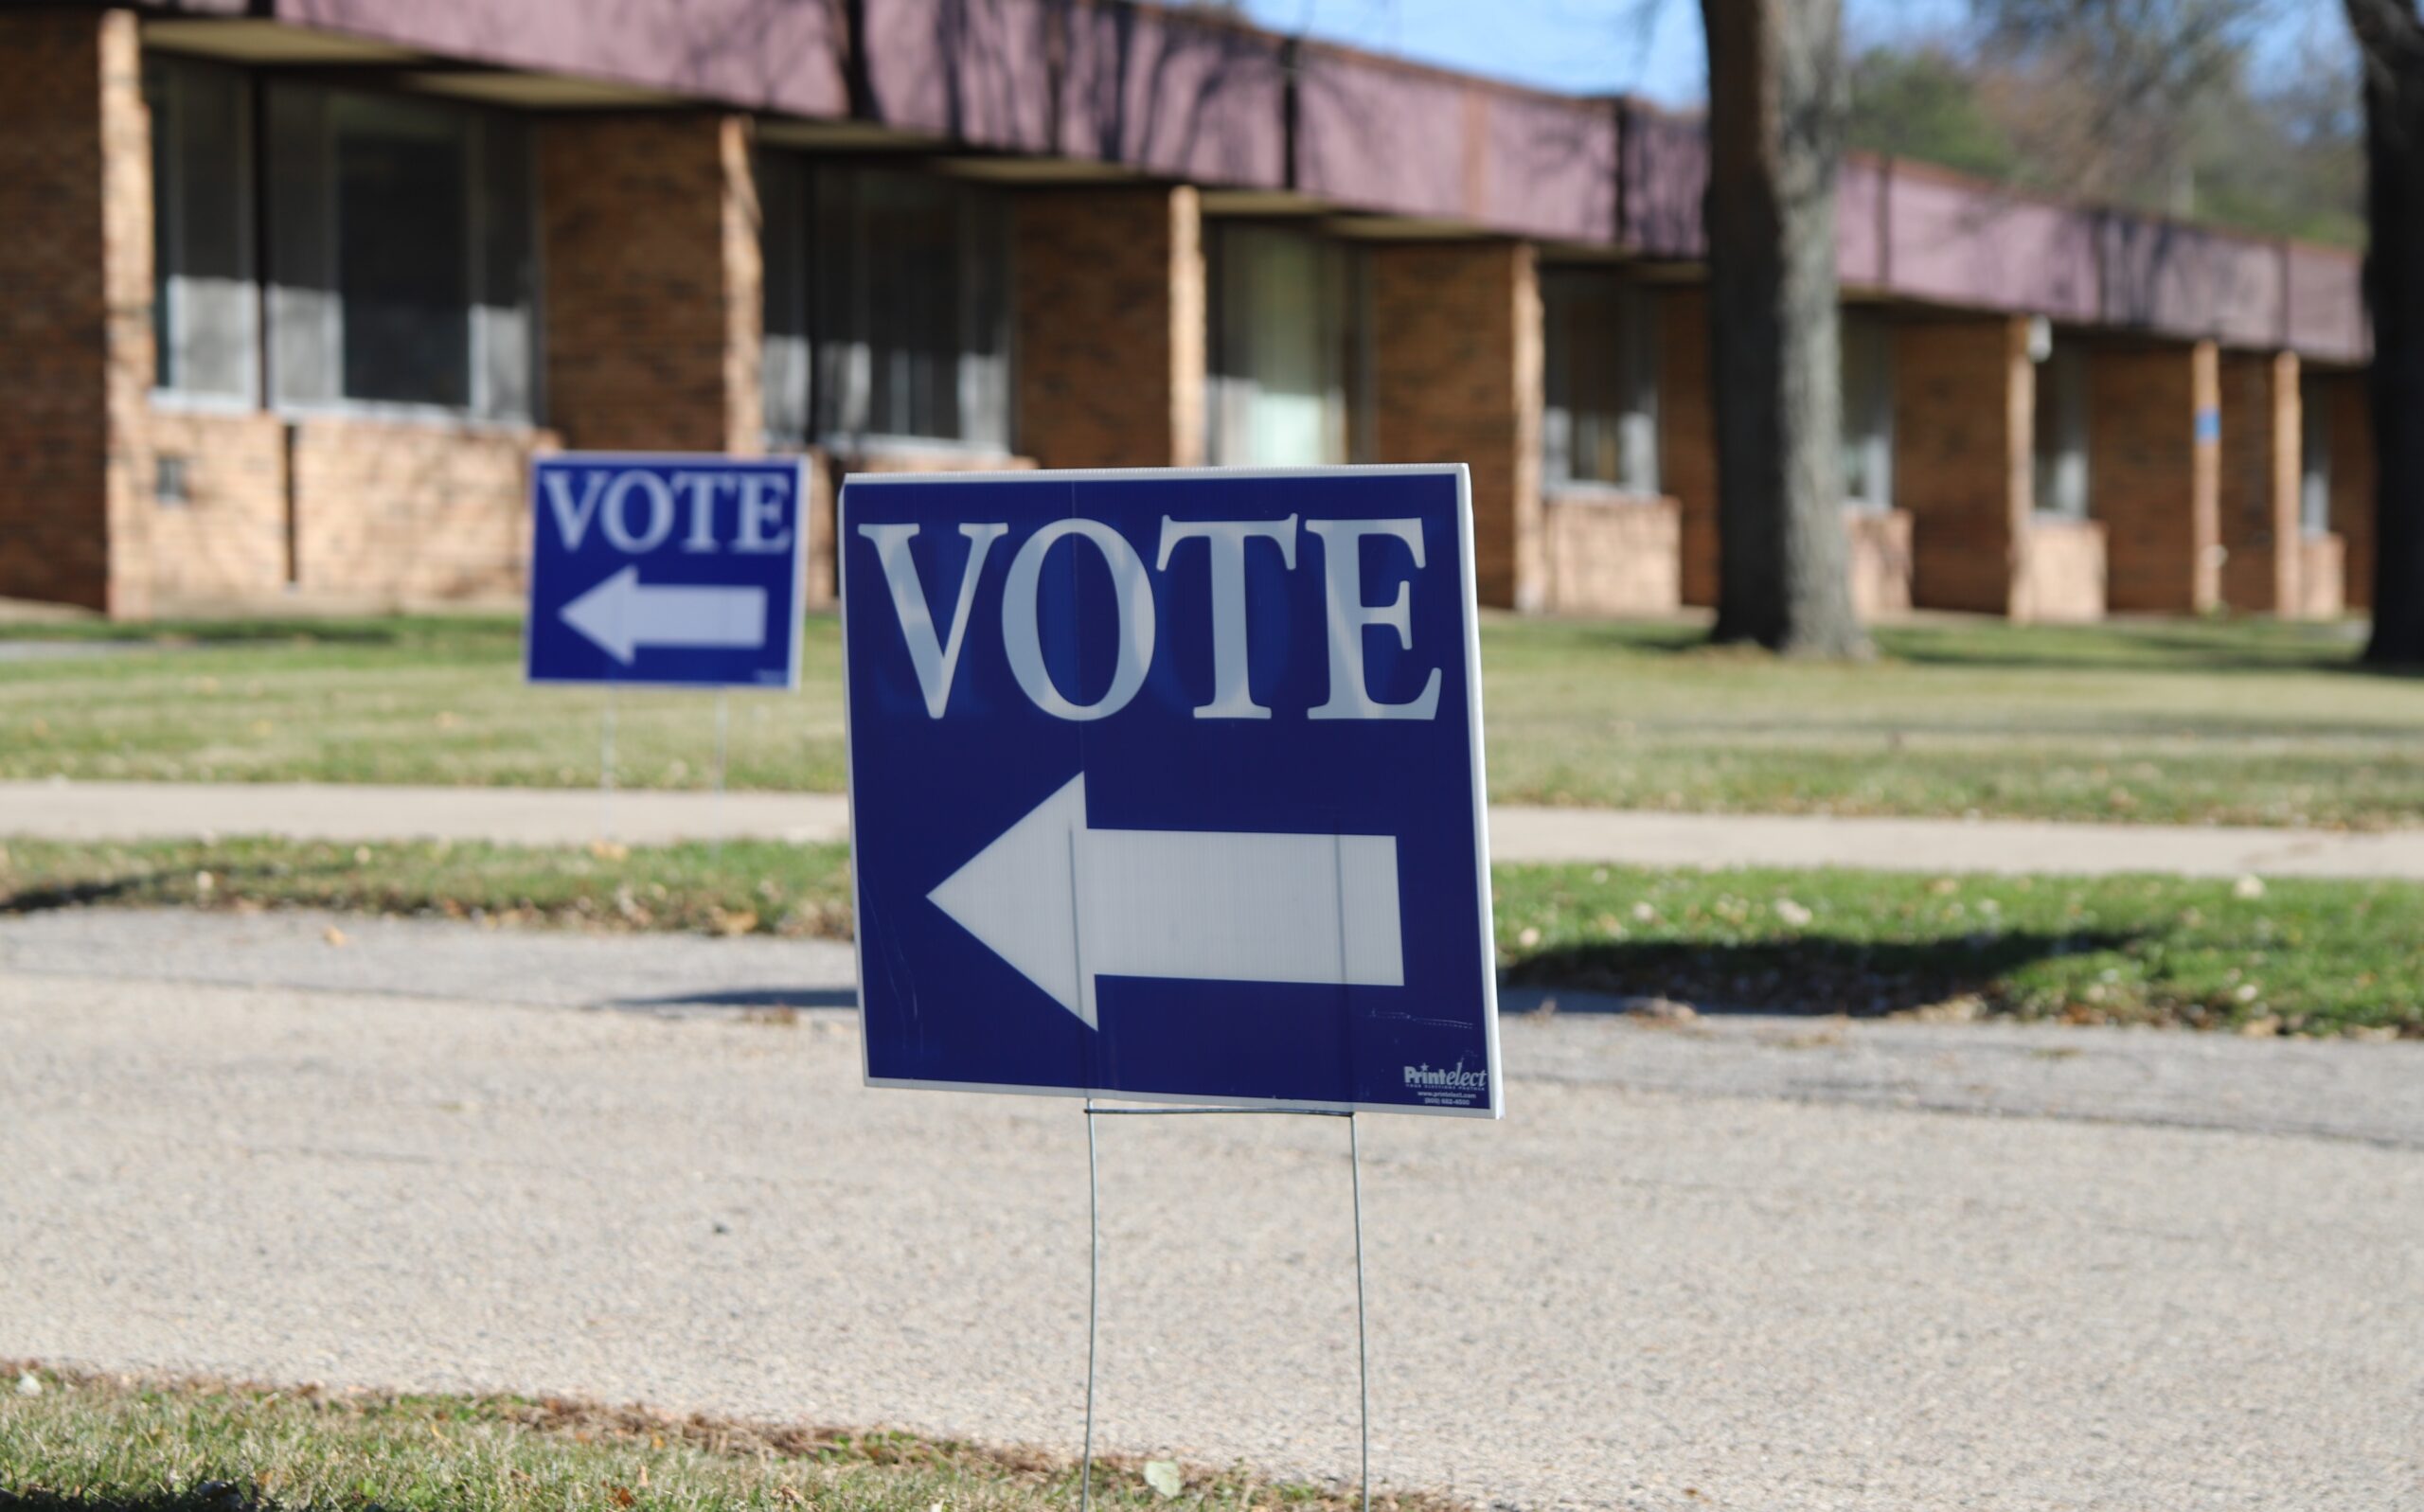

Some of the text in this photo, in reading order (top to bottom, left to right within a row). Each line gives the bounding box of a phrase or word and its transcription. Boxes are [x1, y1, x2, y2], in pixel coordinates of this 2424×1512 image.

[543, 468, 793, 554] VOTE
[856, 513, 1443, 721] VOTE
[1403, 1062, 1488, 1086] Printelect
